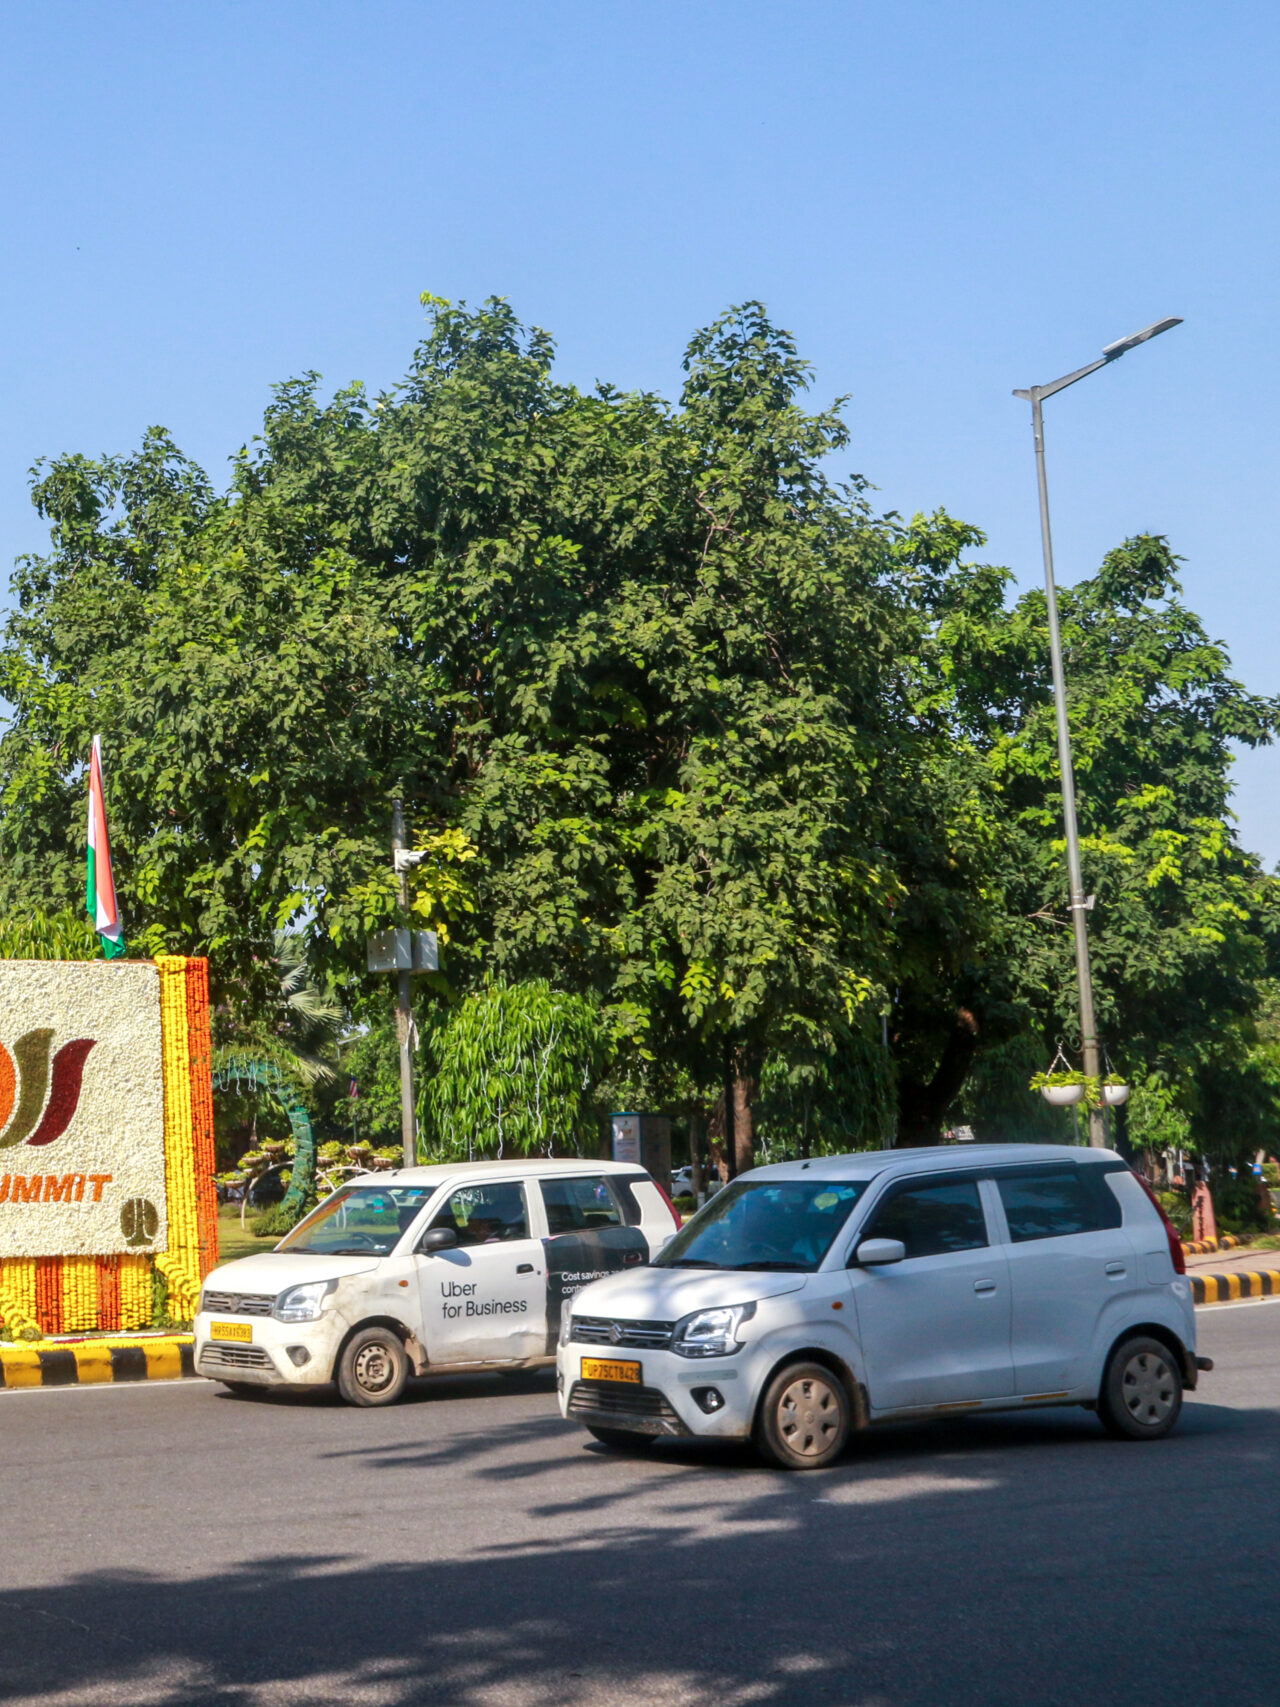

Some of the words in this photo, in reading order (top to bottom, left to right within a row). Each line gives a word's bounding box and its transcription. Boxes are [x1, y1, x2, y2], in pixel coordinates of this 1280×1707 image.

[561, 1271, 580, 1281] Cost
[441, 1281, 477, 1298] Uber
[442, 1302, 462, 1319] for
[466, 1299, 528, 1317] Business
